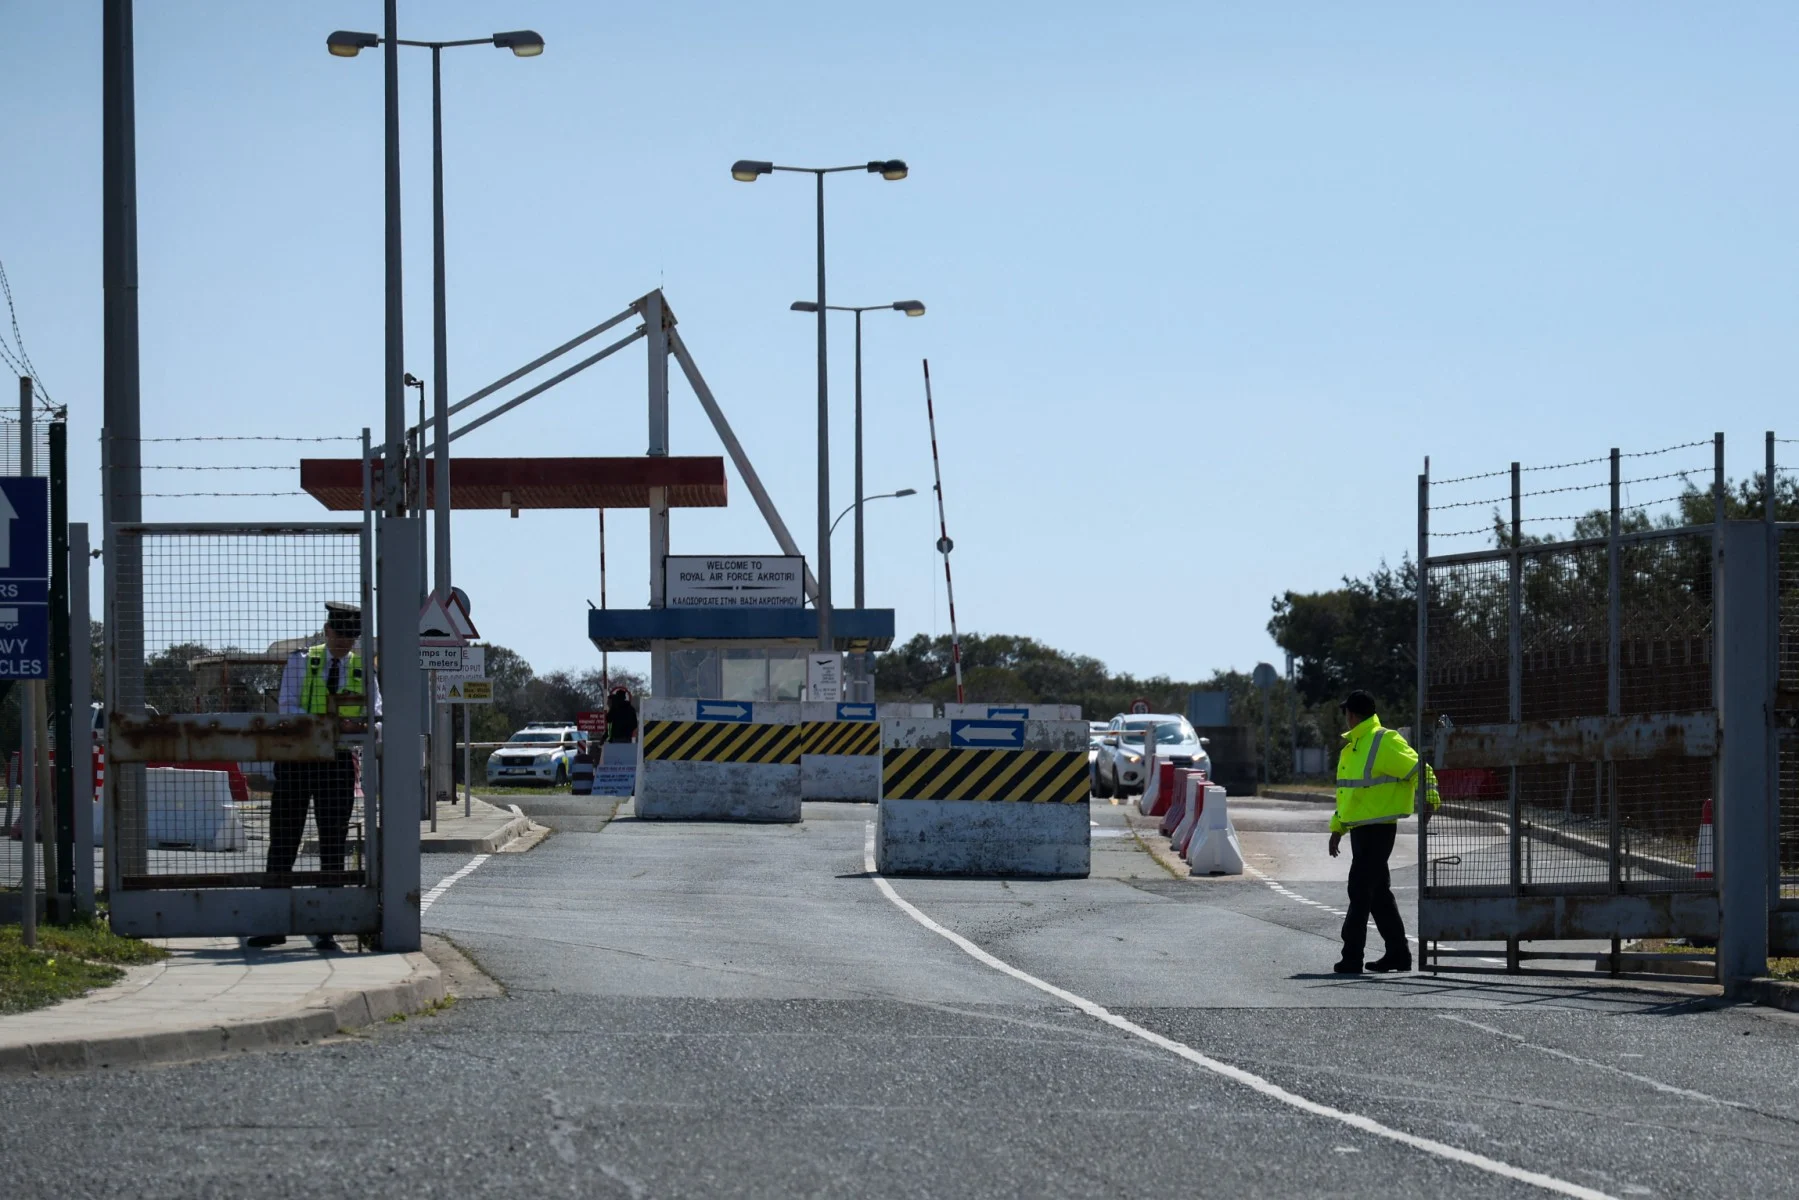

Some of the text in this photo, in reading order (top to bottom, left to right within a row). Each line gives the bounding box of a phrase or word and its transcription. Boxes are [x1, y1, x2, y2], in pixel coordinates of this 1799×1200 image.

[707, 561, 762, 570] WELCOME TO
[680, 572, 795, 581] ROYAL AIR FORCE AKROTIRI
[444, 649, 457, 657] for
[470, 664, 481, 672] PUT
